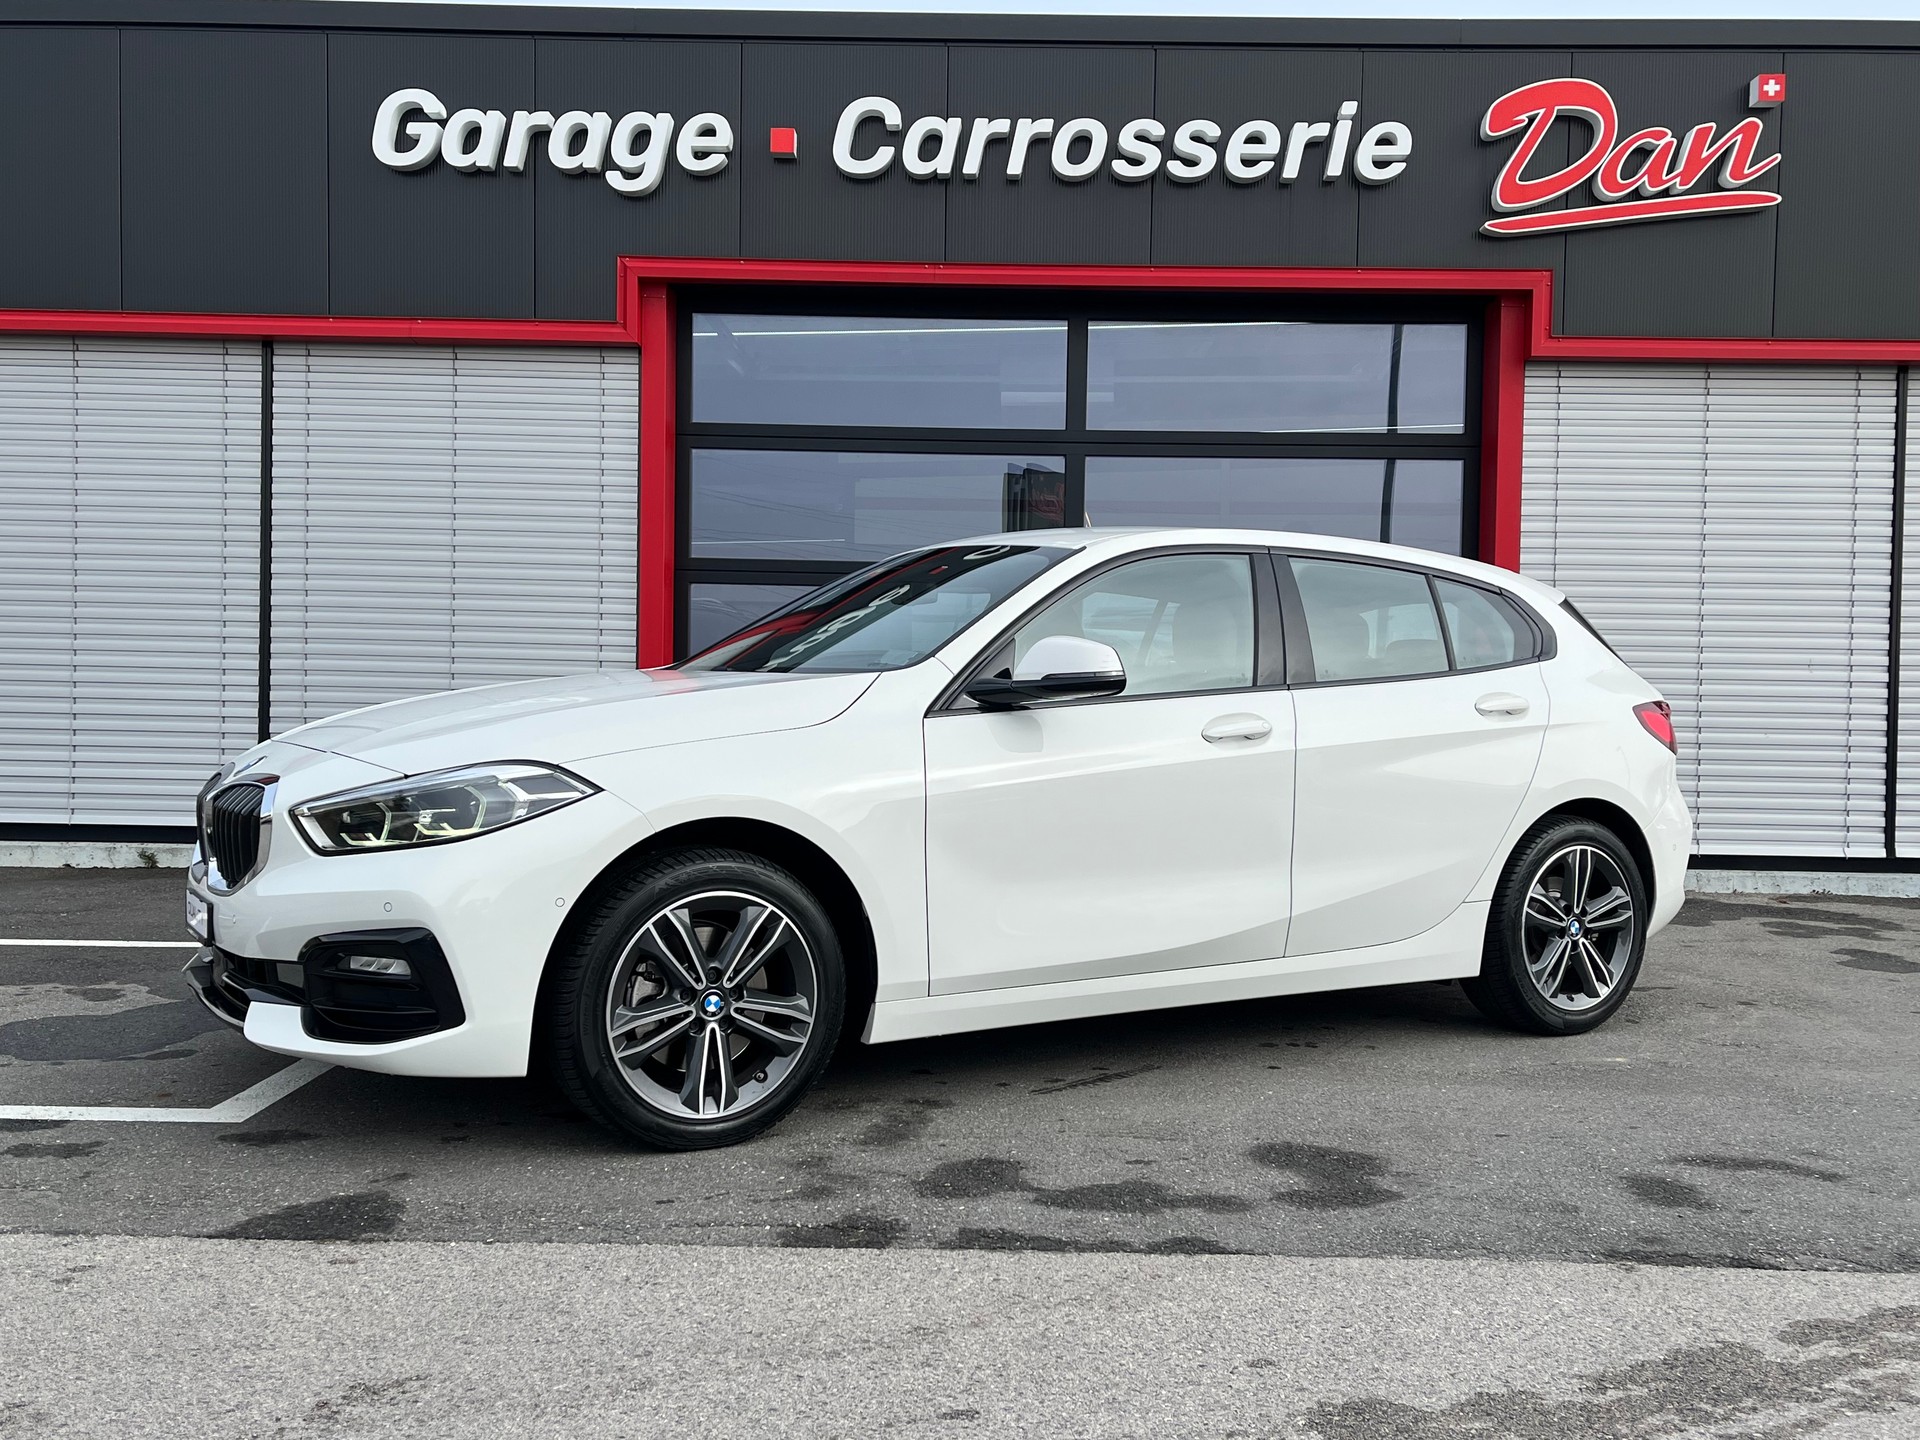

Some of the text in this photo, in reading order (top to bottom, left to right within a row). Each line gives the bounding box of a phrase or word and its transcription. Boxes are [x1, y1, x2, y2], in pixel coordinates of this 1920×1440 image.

[371, 77, 1782, 213] Garage Carrosserie Dan
